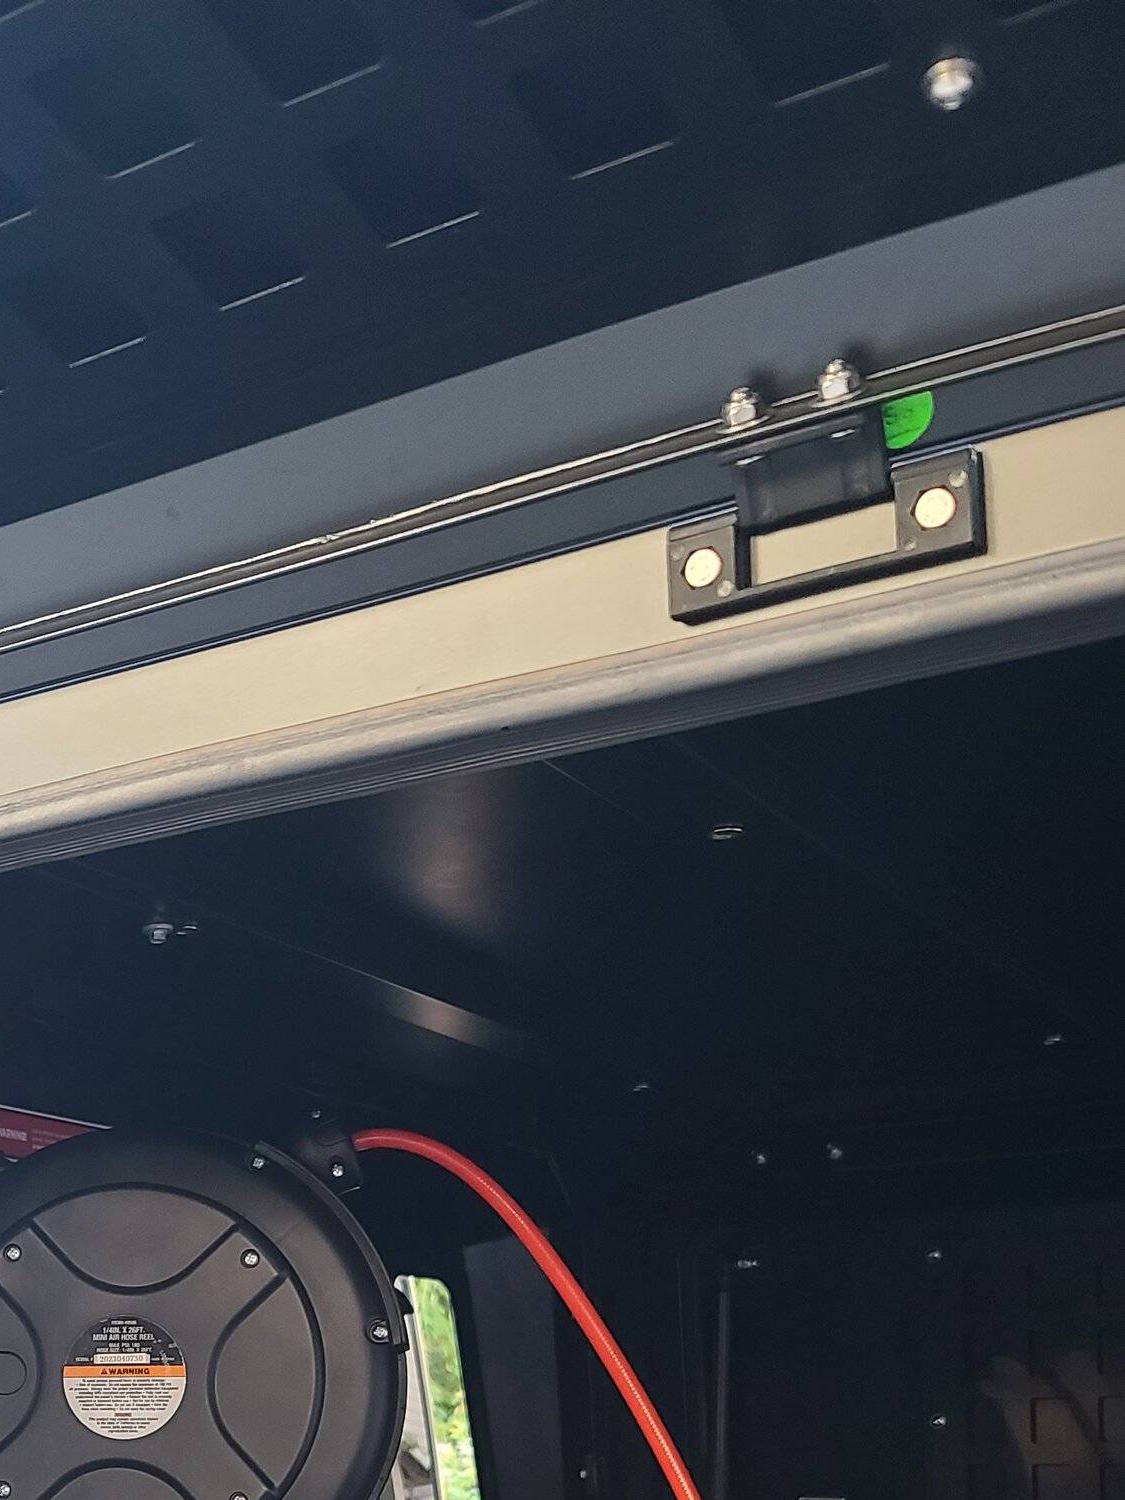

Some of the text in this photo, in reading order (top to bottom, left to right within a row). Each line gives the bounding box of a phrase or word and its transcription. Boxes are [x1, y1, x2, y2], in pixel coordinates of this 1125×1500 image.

[92, 1333, 155, 1341] MINI AIR HOSE REEL
[108, 1367, 150, 1375] WARNING
